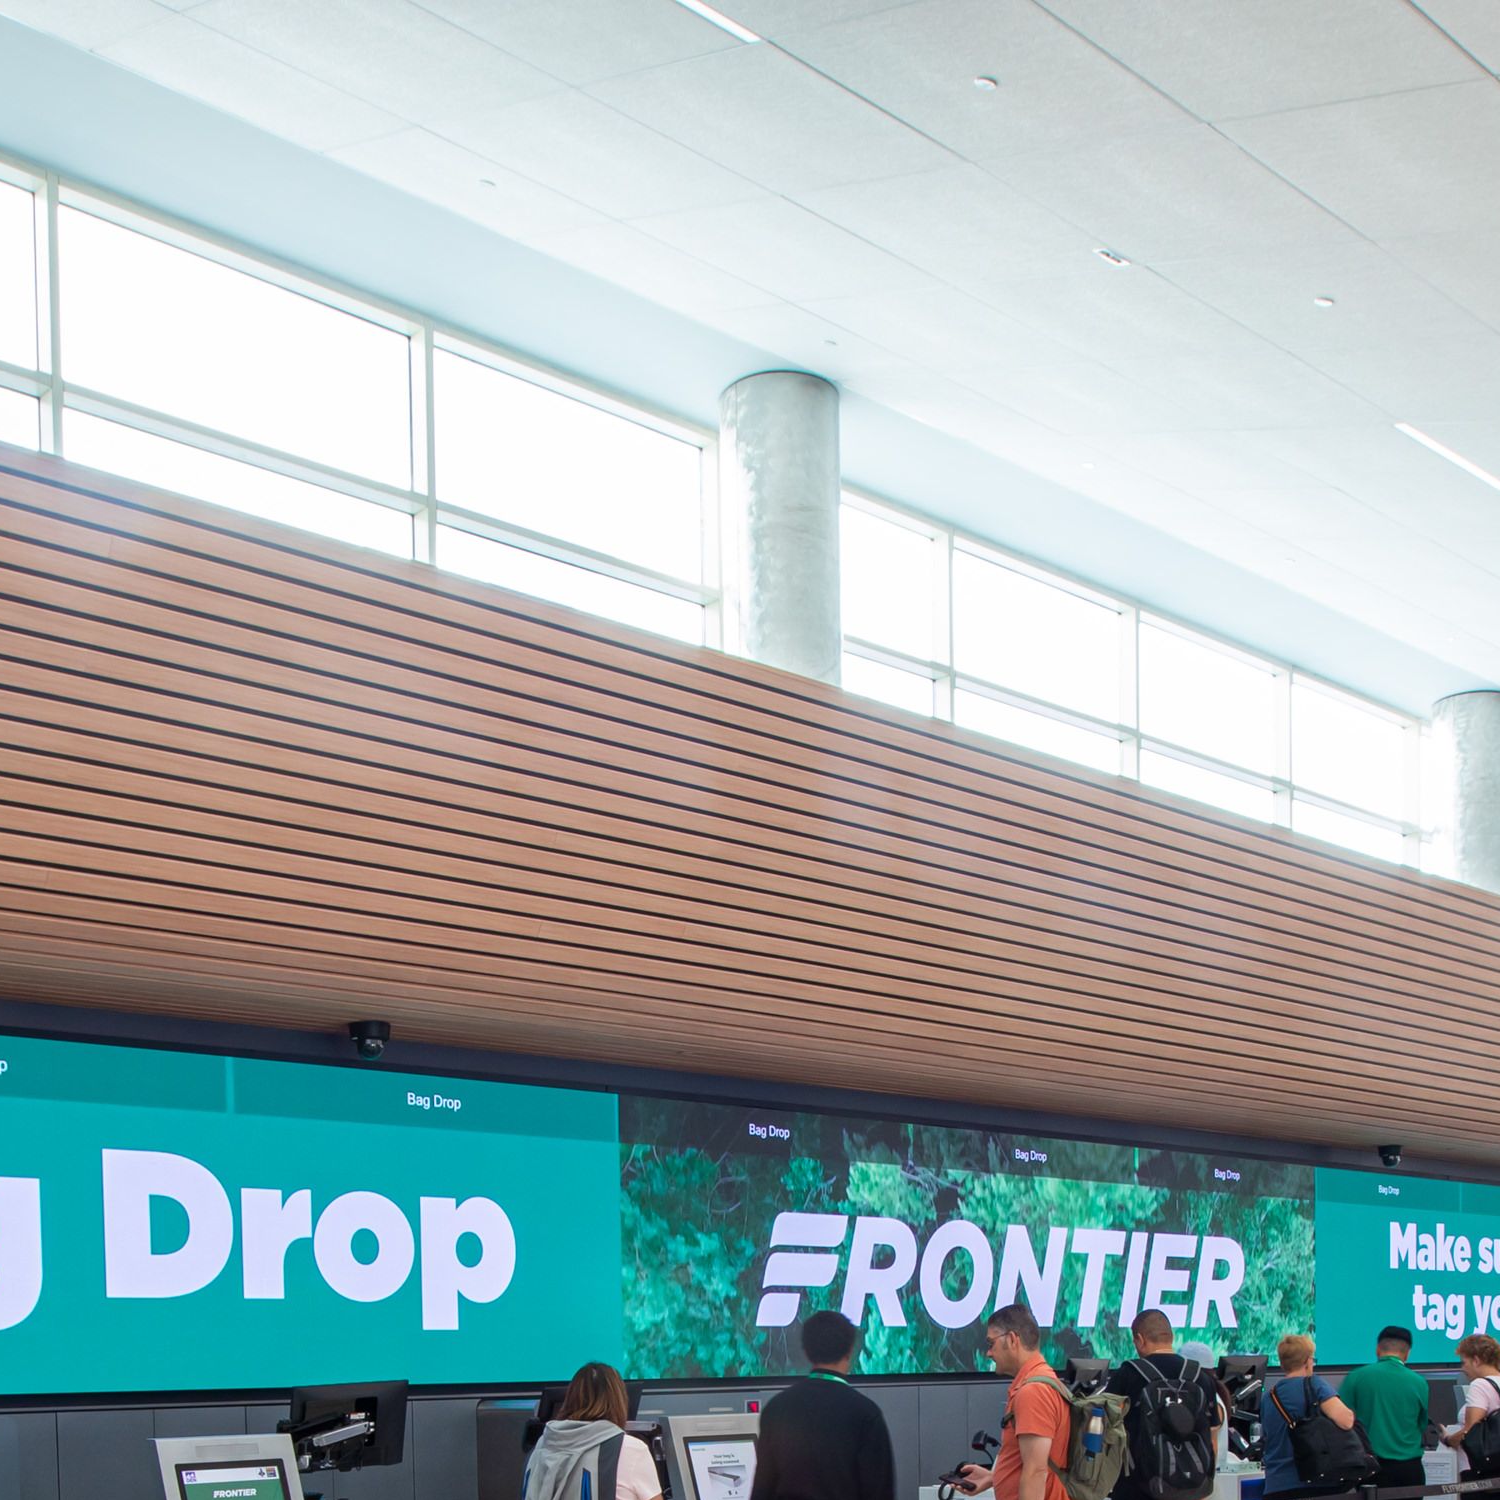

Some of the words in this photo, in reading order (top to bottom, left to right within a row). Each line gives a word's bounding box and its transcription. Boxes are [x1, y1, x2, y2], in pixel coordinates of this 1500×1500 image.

[407, 1091, 431, 1110] Bag
[433, 1094, 462, 1112] Drop
[748, 1123, 767, 1139] Bag
[768, 1125, 790, 1140] Drop
[1015, 1149, 1030, 1162] Bag
[1030, 1150, 1048, 1163] Drop
[1214, 1168, 1226, 1180] Bag
[1227, 1169, 1241, 1181] Drop
[1378, 1184, 1389, 1195] Bag
[1389, 1186, 1400, 1196] Drop
[102, 1147, 517, 1331] Drop
[1389, 1221, 1472, 1273] Make
[755, 1211, 1246, 1329] FRONTIER
[1413, 1284, 1465, 1340] tag
[213, 1488, 257, 1498] FRONTIER
[1442, 1480, 1492, 1493] FLYFRONTIER.COM
